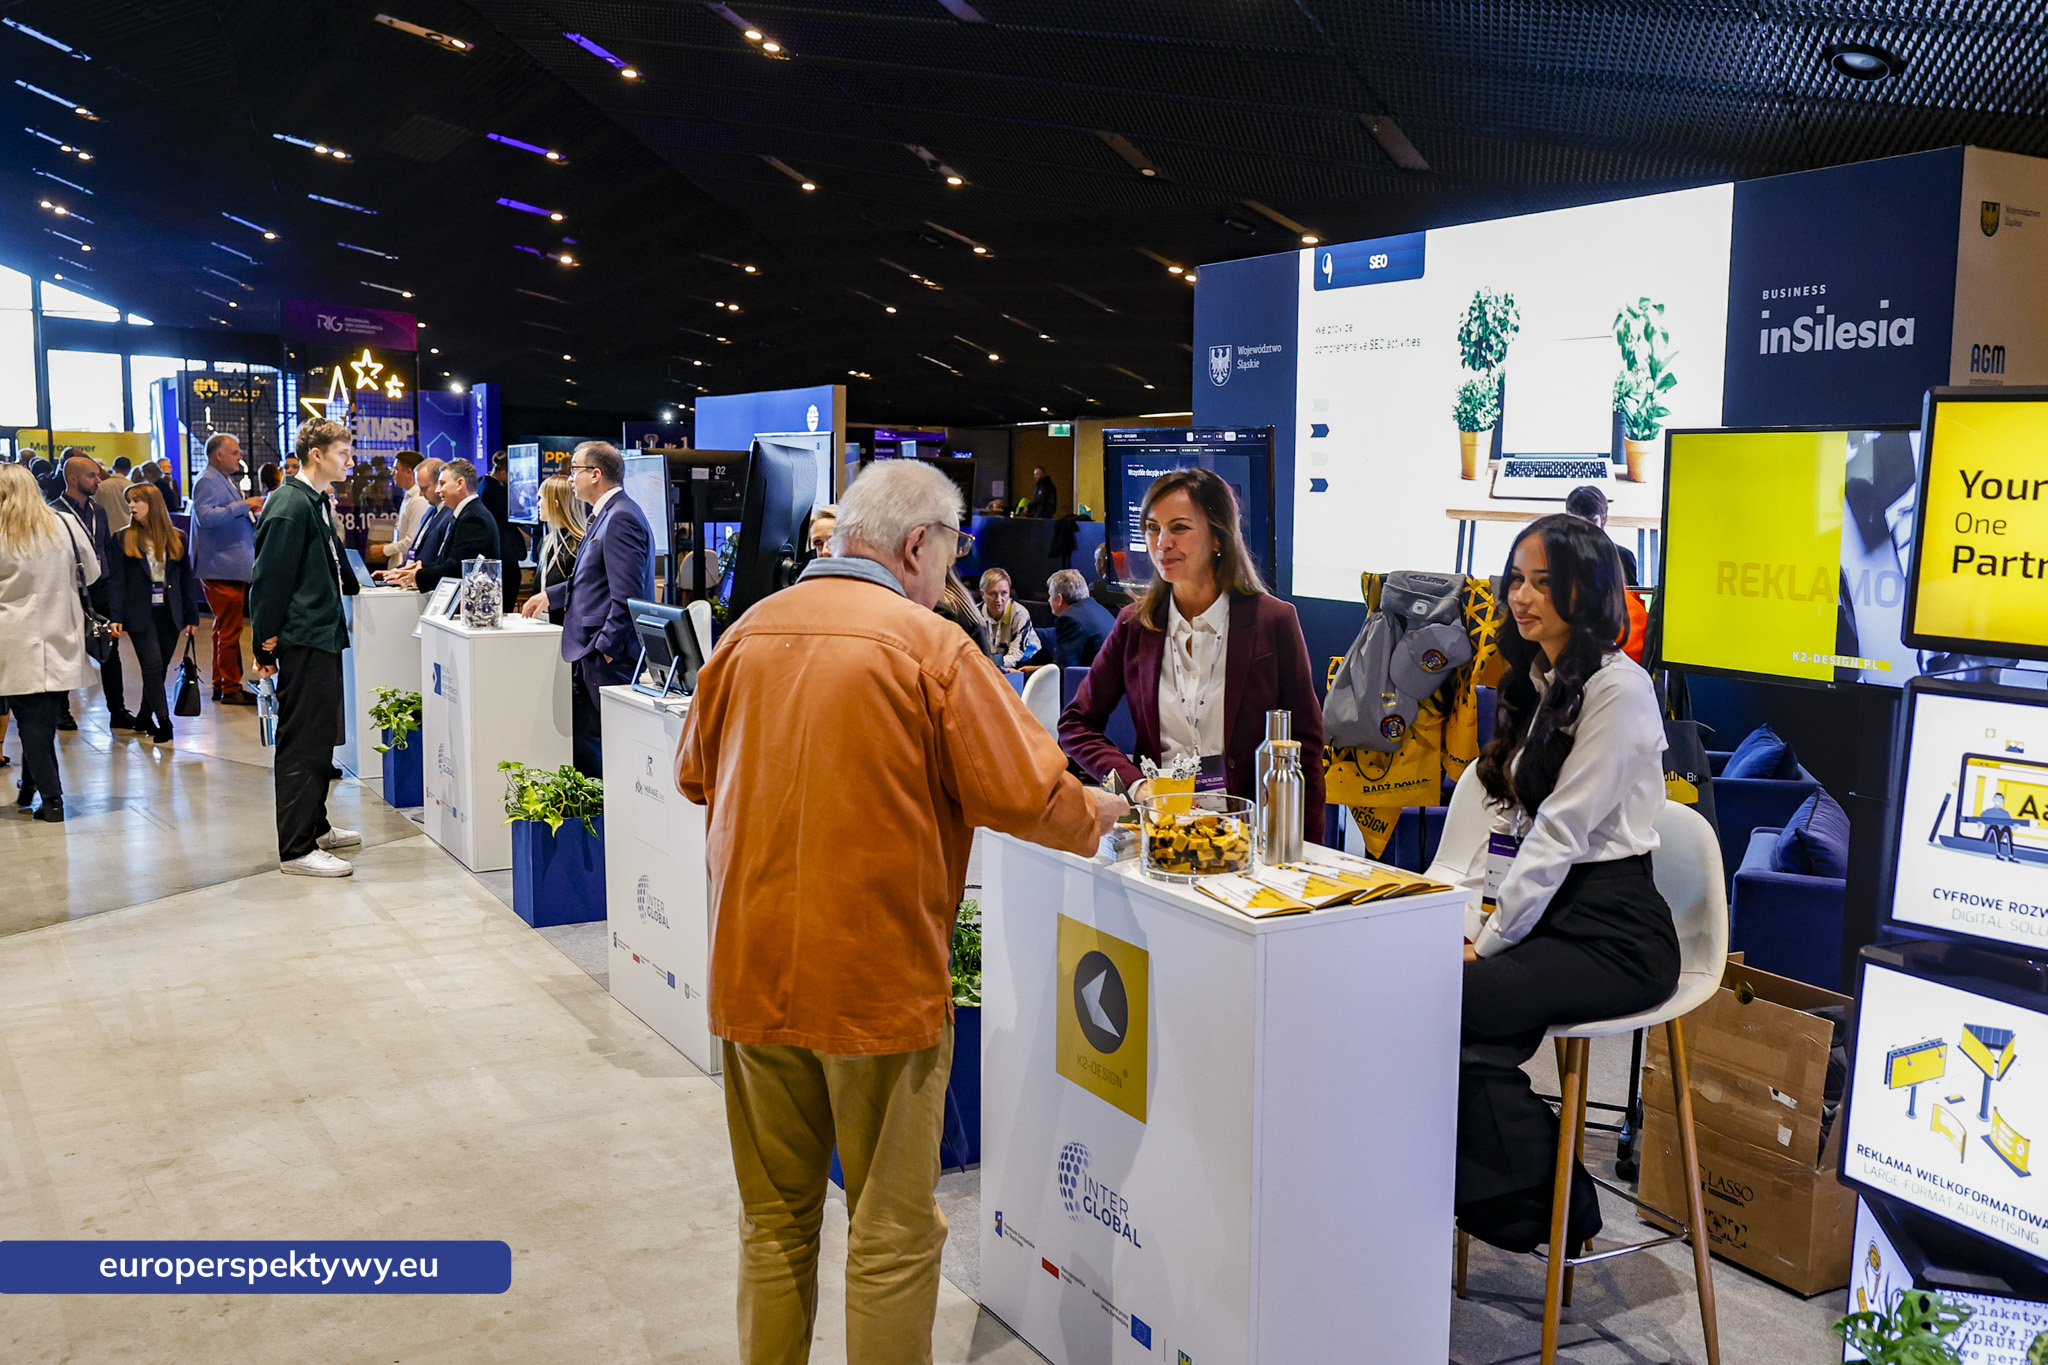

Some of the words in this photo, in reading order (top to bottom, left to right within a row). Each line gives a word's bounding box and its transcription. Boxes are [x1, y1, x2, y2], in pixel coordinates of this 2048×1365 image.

[1369, 253, 1388, 270] SEO
[1762, 284, 1827, 300] BUSINESS
[1759, 299, 1915, 355] inSilesia
[1237, 344, 1282, 357] Województwo
[1970, 343, 2006, 374] AGM
[1959, 470, 2048, 501] Your
[1955, 512, 2007, 535] One
[1792, 651, 1878, 670] K2-DESIGN.PL
[1351, 806, 1389, 834] DESIGN
[1932, 887, 2004, 911] CYFROWE
[1951, 908, 2003, 928] DIGITAL
[1857, 1143, 1912, 1175] REKLAMA
[1083, 1173, 1128, 1221] INTER
[1863, 1162, 1951, 1209] LARGE-FORMAT
[1957, 1201, 2039, 1246] ADVERTISING
[1083, 1195, 1142, 1250] GLOBAL
